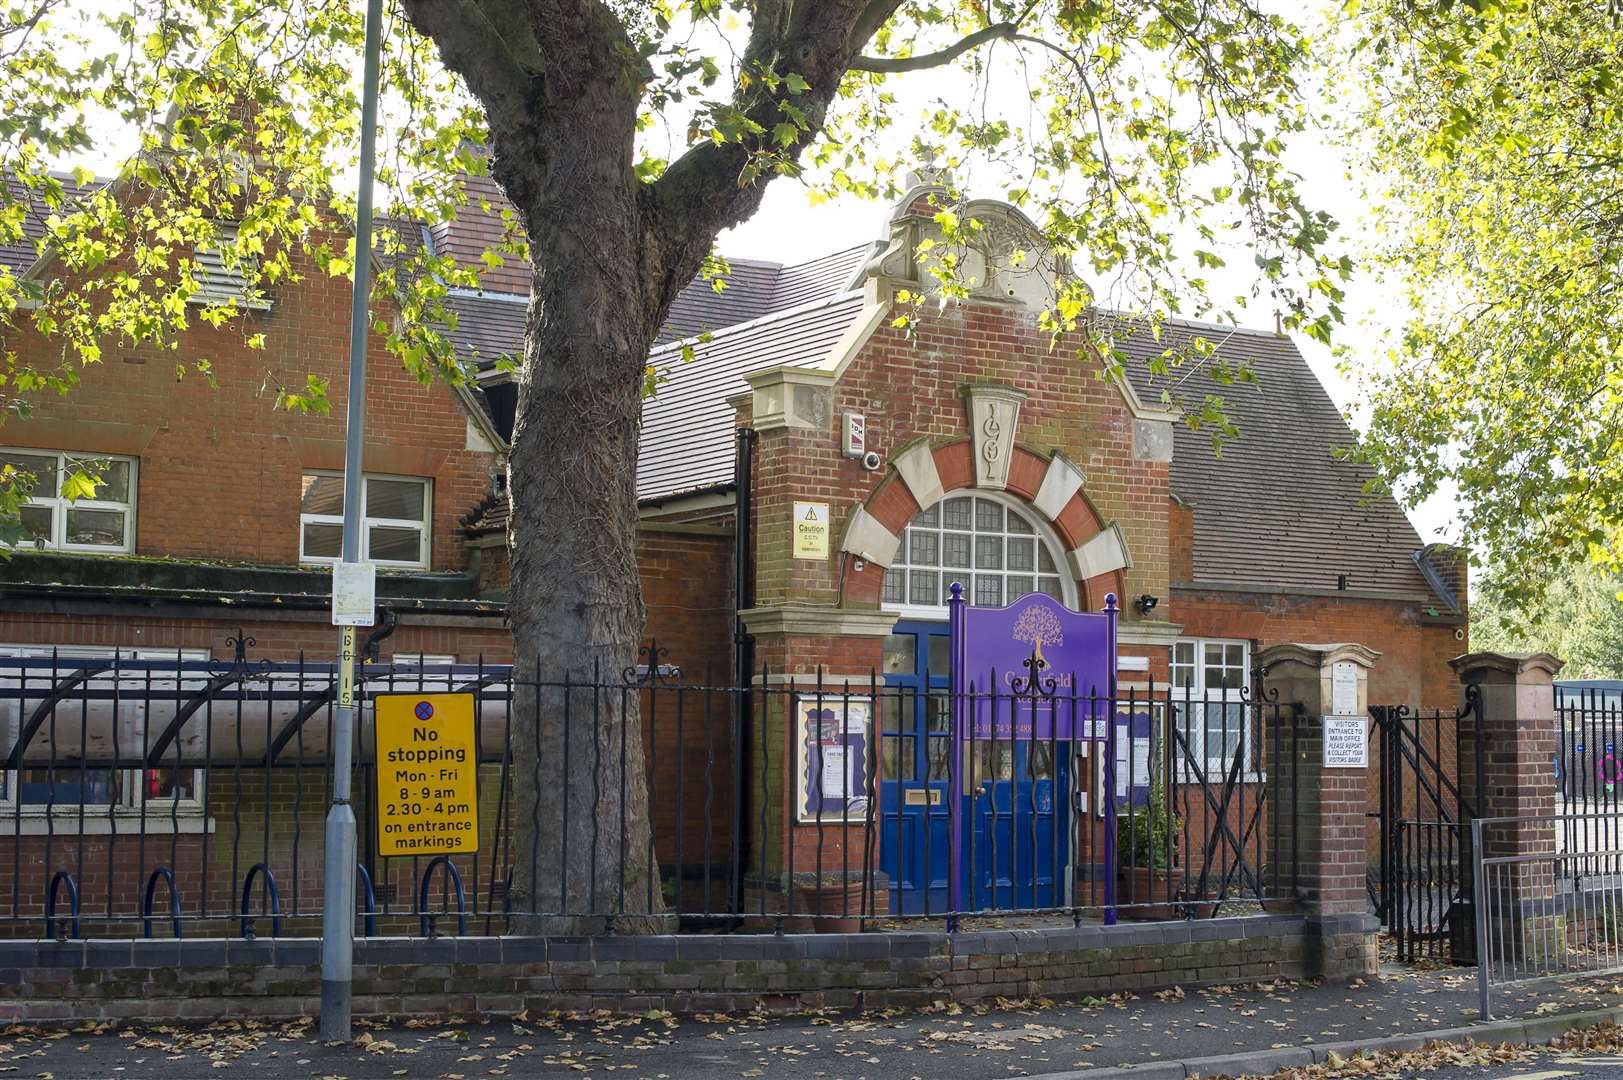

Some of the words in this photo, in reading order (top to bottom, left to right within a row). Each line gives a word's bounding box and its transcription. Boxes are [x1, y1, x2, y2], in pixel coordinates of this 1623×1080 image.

[799, 524, 825, 533] Caution
[1005, 671, 1071, 692] Cpereld
[413, 727, 438, 741] No
[982, 723, 1004, 733] 0174
[388, 746, 465, 763] stopping
[396, 770, 426, 782] Mon
[440, 769, 458, 780] Fri
[400, 788, 408, 799] 8
[421, 787, 430, 799] 9
[434, 789, 455, 798] am
[386, 803, 422, 816] 2.30
[434, 803, 443, 814] 4
[447, 803, 469, 816] pm
[384, 823, 402, 833] on
[407, 820, 472, 832] entrance
[395, 835, 462, 848] markings
